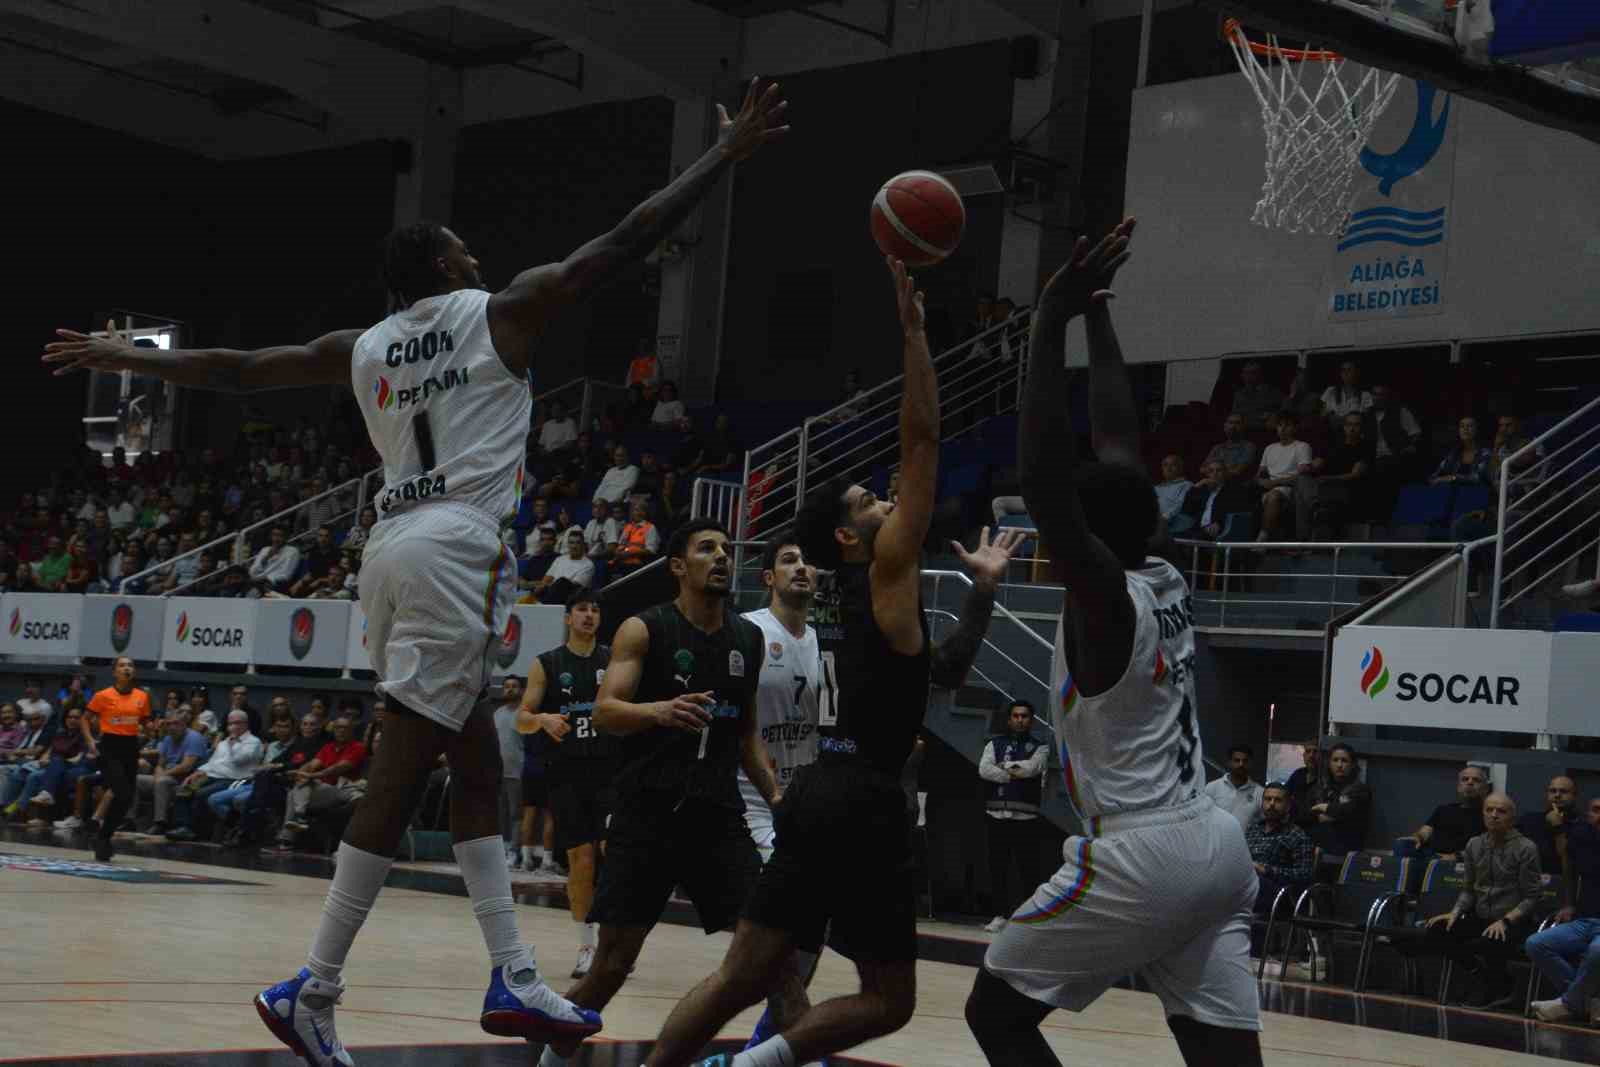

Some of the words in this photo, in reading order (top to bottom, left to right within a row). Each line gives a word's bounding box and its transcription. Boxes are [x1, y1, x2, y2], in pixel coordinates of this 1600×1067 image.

[1350, 255, 1425, 282] ALİAĞA
[1333, 280, 1440, 313] BELEDİYESİ
[413, 410, 436, 476] 1
[23, 621, 71, 641] SOCAR
[191, 627, 243, 648] SOCAR
[793, 676, 807, 705] 7
[1395, 672, 1520, 706] SOCAR
